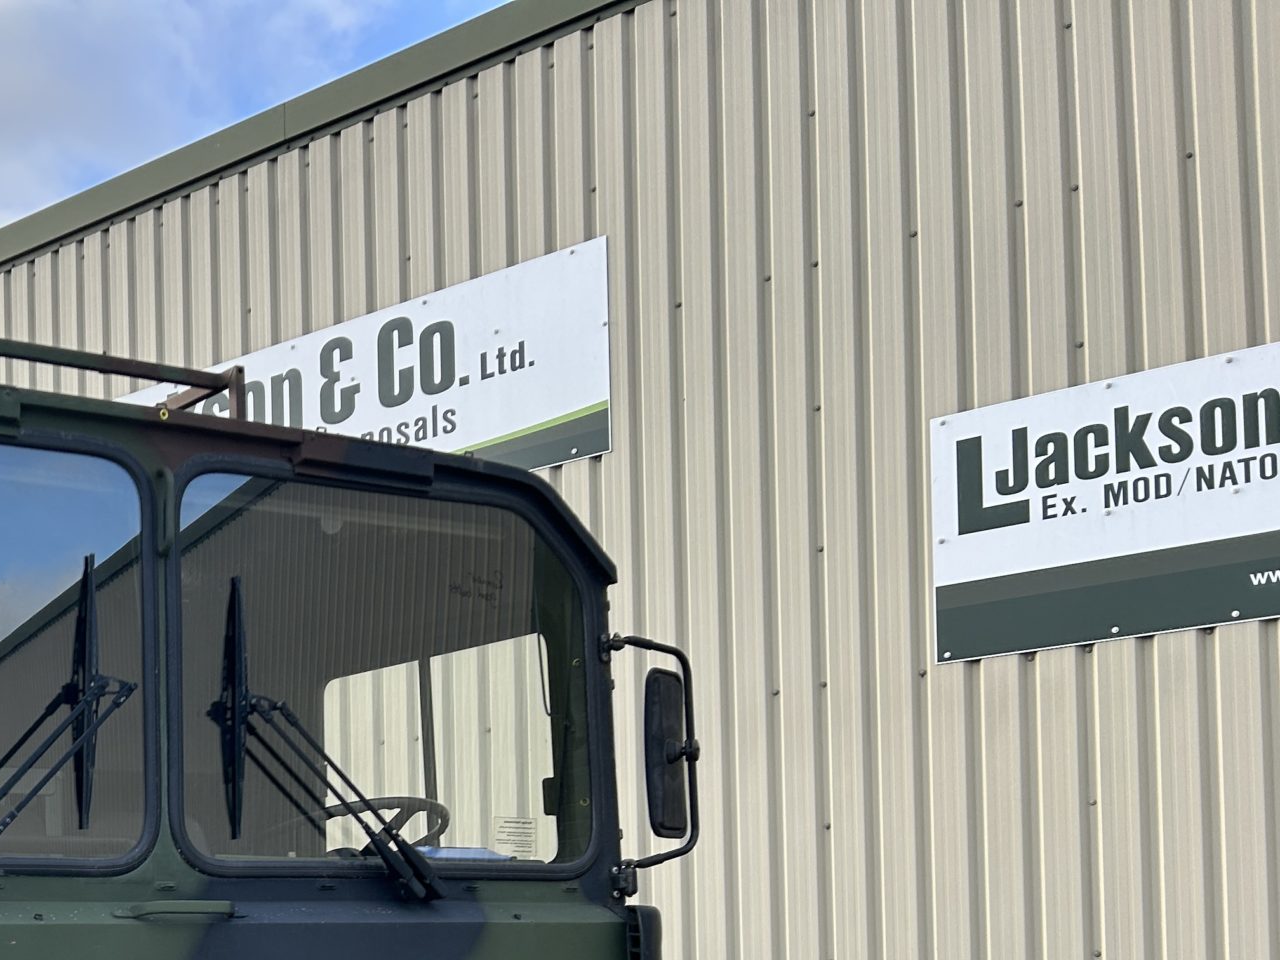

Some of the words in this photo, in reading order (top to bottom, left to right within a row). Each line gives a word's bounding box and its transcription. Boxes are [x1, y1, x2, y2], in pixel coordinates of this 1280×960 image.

[320, 336, 360, 424] &
[377, 316, 470, 408] Co.
[480, 340, 535, 380] Ltd.
[1042, 494, 1087, 520] Ex.
